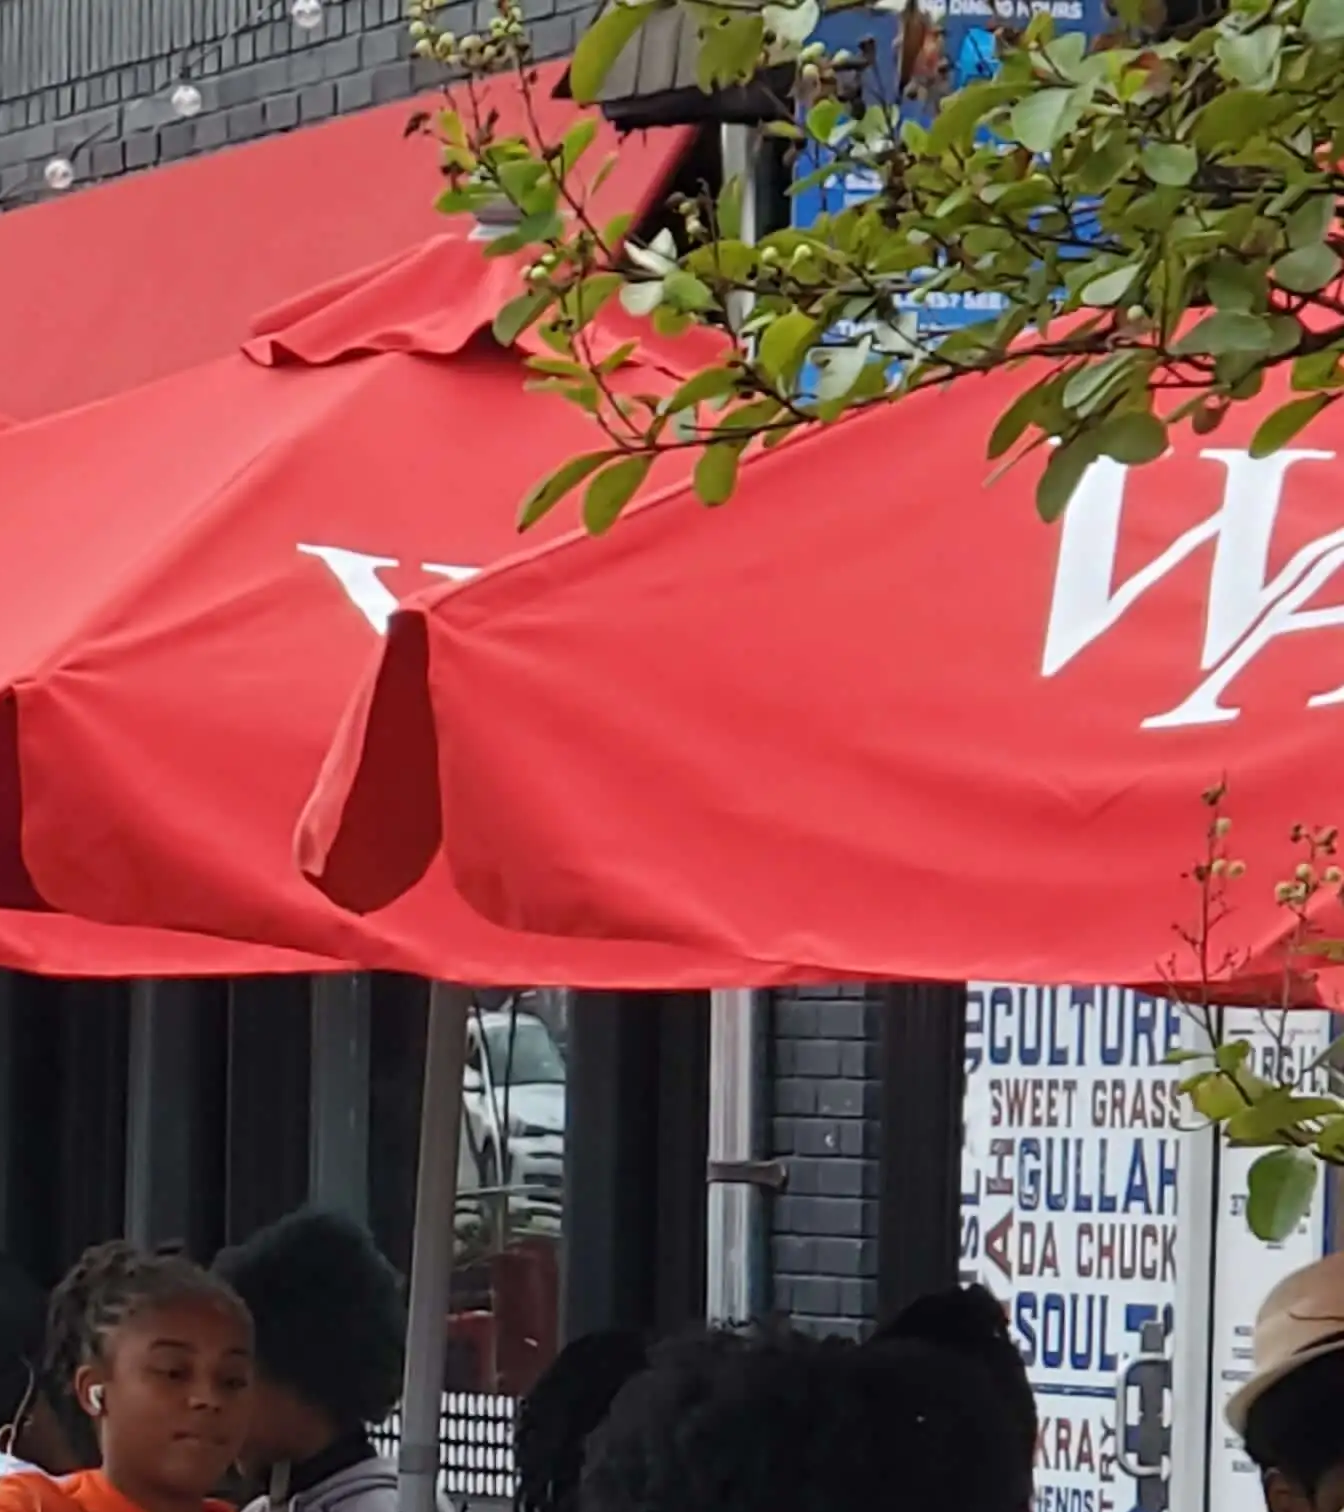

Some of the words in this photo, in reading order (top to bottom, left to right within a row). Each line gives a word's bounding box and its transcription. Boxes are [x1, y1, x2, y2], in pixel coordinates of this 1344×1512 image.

[989, 985, 1180, 1066] CULTURE
[989, 1078, 1078, 1129] SWEET
[1090, 1079, 1180, 1130] GRASS
[1018, 1137, 1181, 1216] GULLAH
[1018, 1221, 1061, 1278] DA
[1075, 1222, 1178, 1284] CHUCK
[1015, 1291, 1119, 1373] SOUL
[1033, 1416, 1096, 1474] KRA
